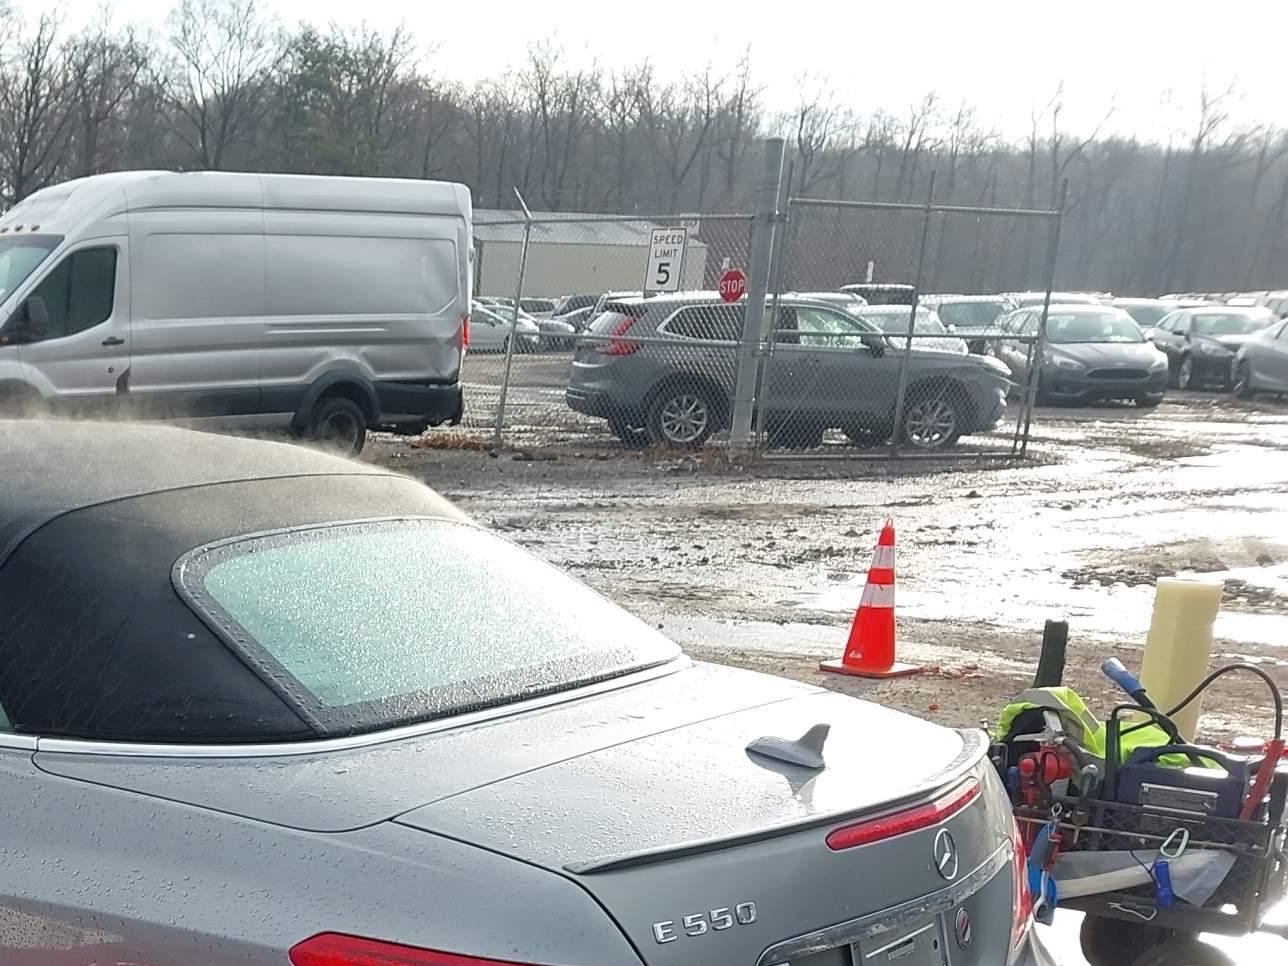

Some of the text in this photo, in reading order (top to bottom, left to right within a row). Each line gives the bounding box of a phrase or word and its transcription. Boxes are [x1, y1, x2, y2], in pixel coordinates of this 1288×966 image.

[653, 235, 683, 245] SPEED
[654, 249, 678, 258] LIMIT
[656, 262, 670, 285] 5
[721, 280, 744, 294] STOP
[652, 901, 757, 944] E 550
